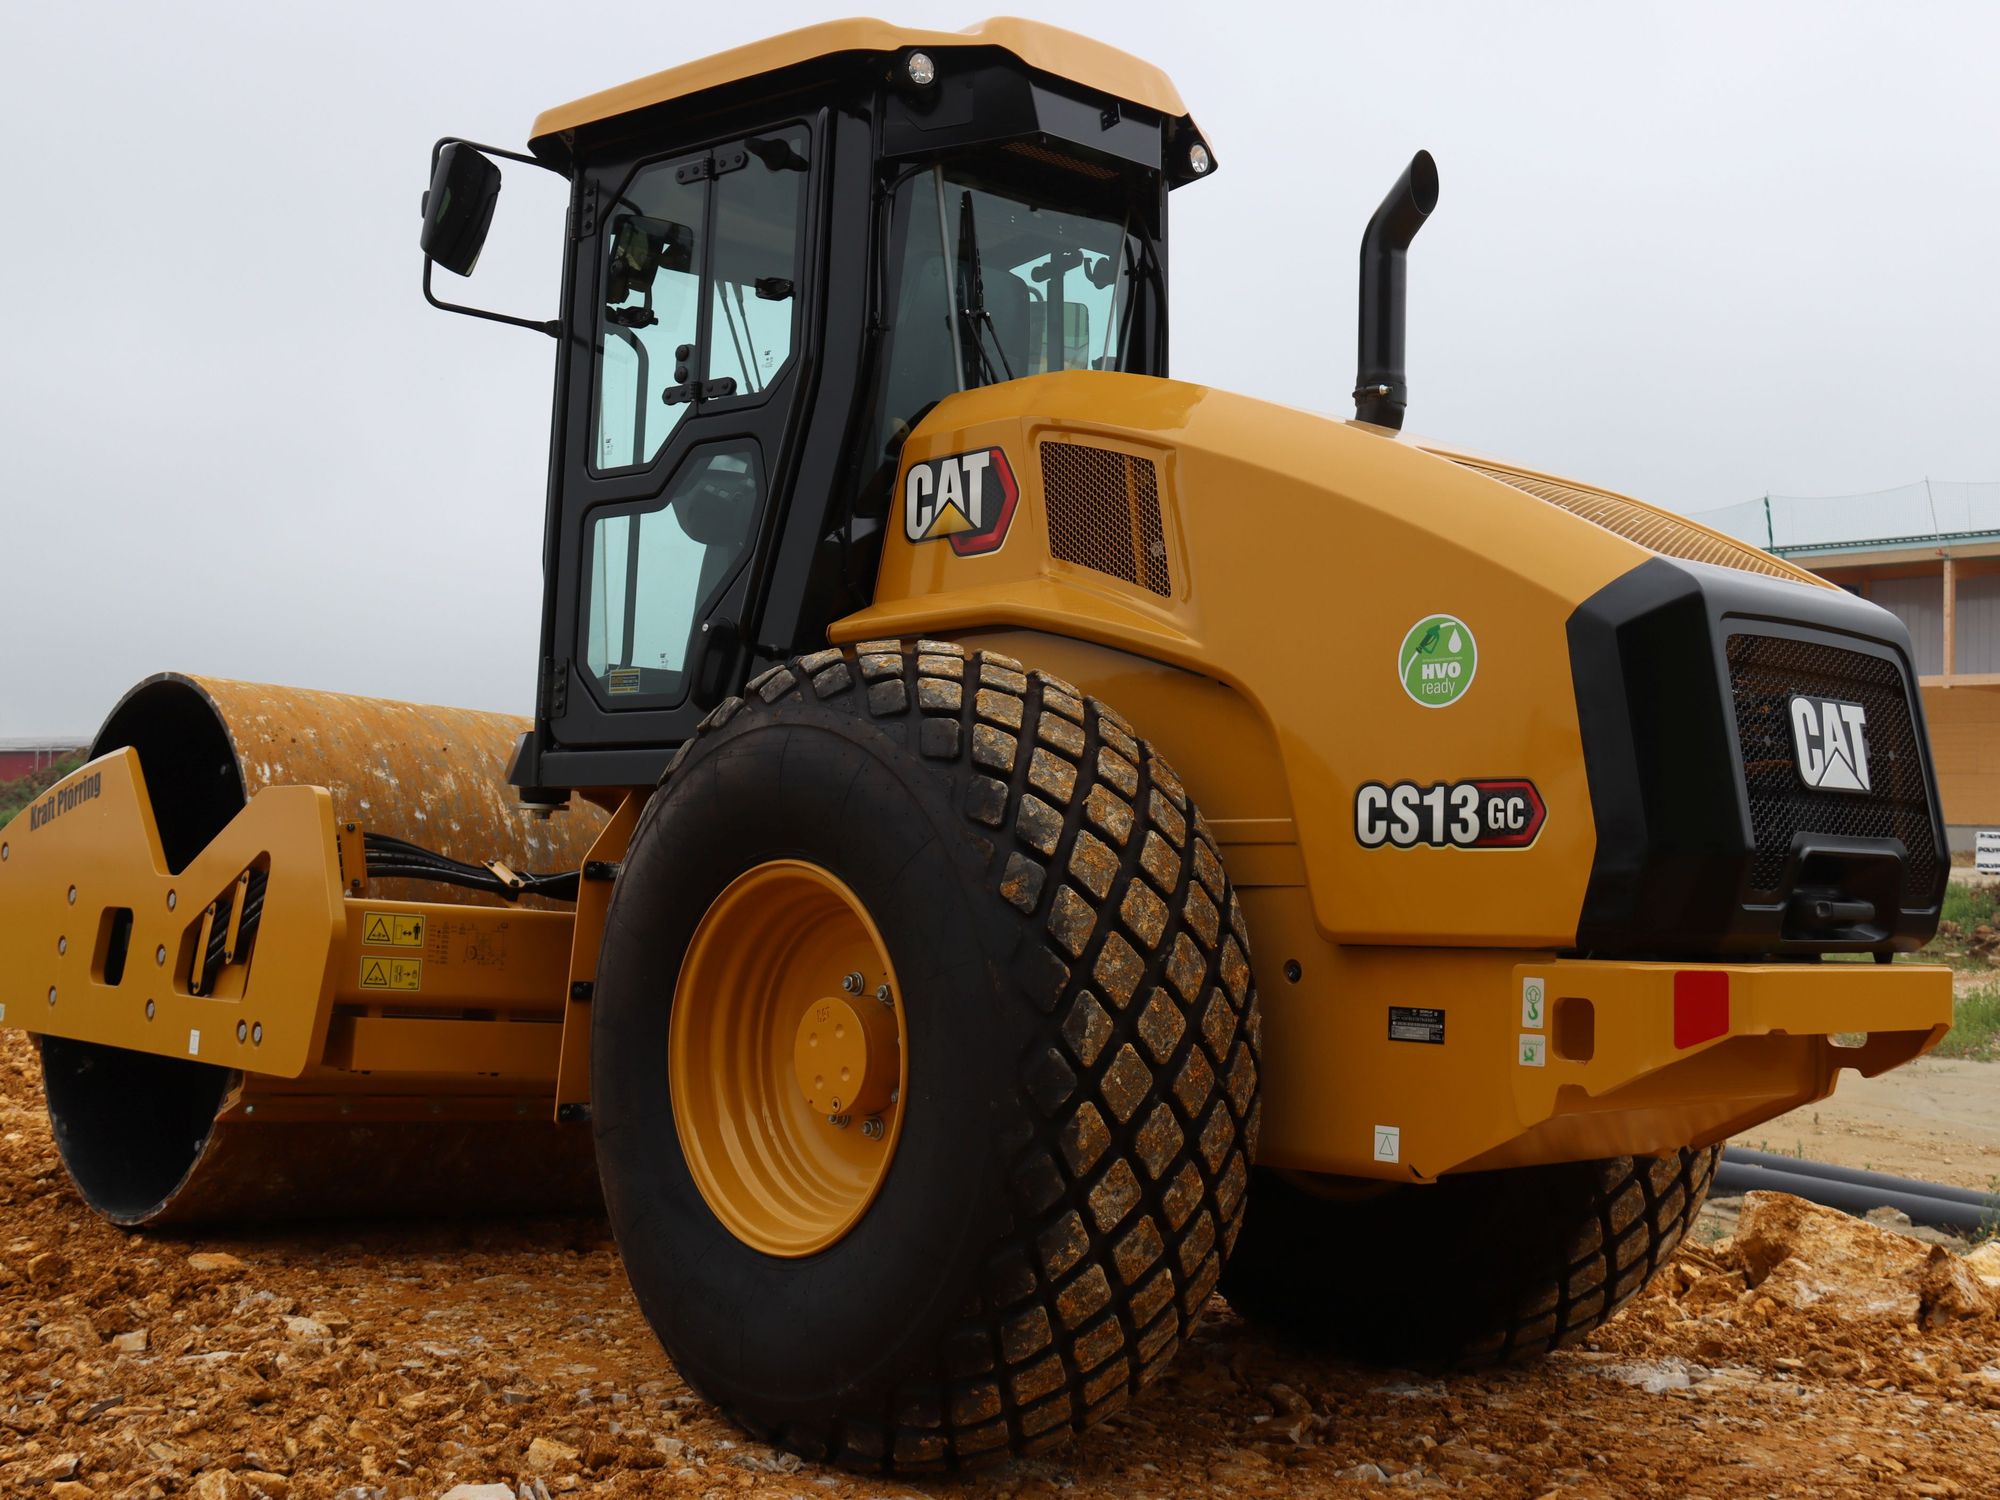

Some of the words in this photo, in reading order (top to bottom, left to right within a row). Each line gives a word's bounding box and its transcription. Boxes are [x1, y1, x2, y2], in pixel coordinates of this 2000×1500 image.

[906, 451, 990, 540] CAT
[1421, 661, 1461, 680] HVO
[1421, 678, 1456, 697] ready
[1791, 698, 1871, 790] CAT
[30, 796, 55, 832] Kraft
[57, 772, 102, 816] Pförring
[1357, 784, 1480, 844] CS13
[1487, 797, 1525, 830] GC
